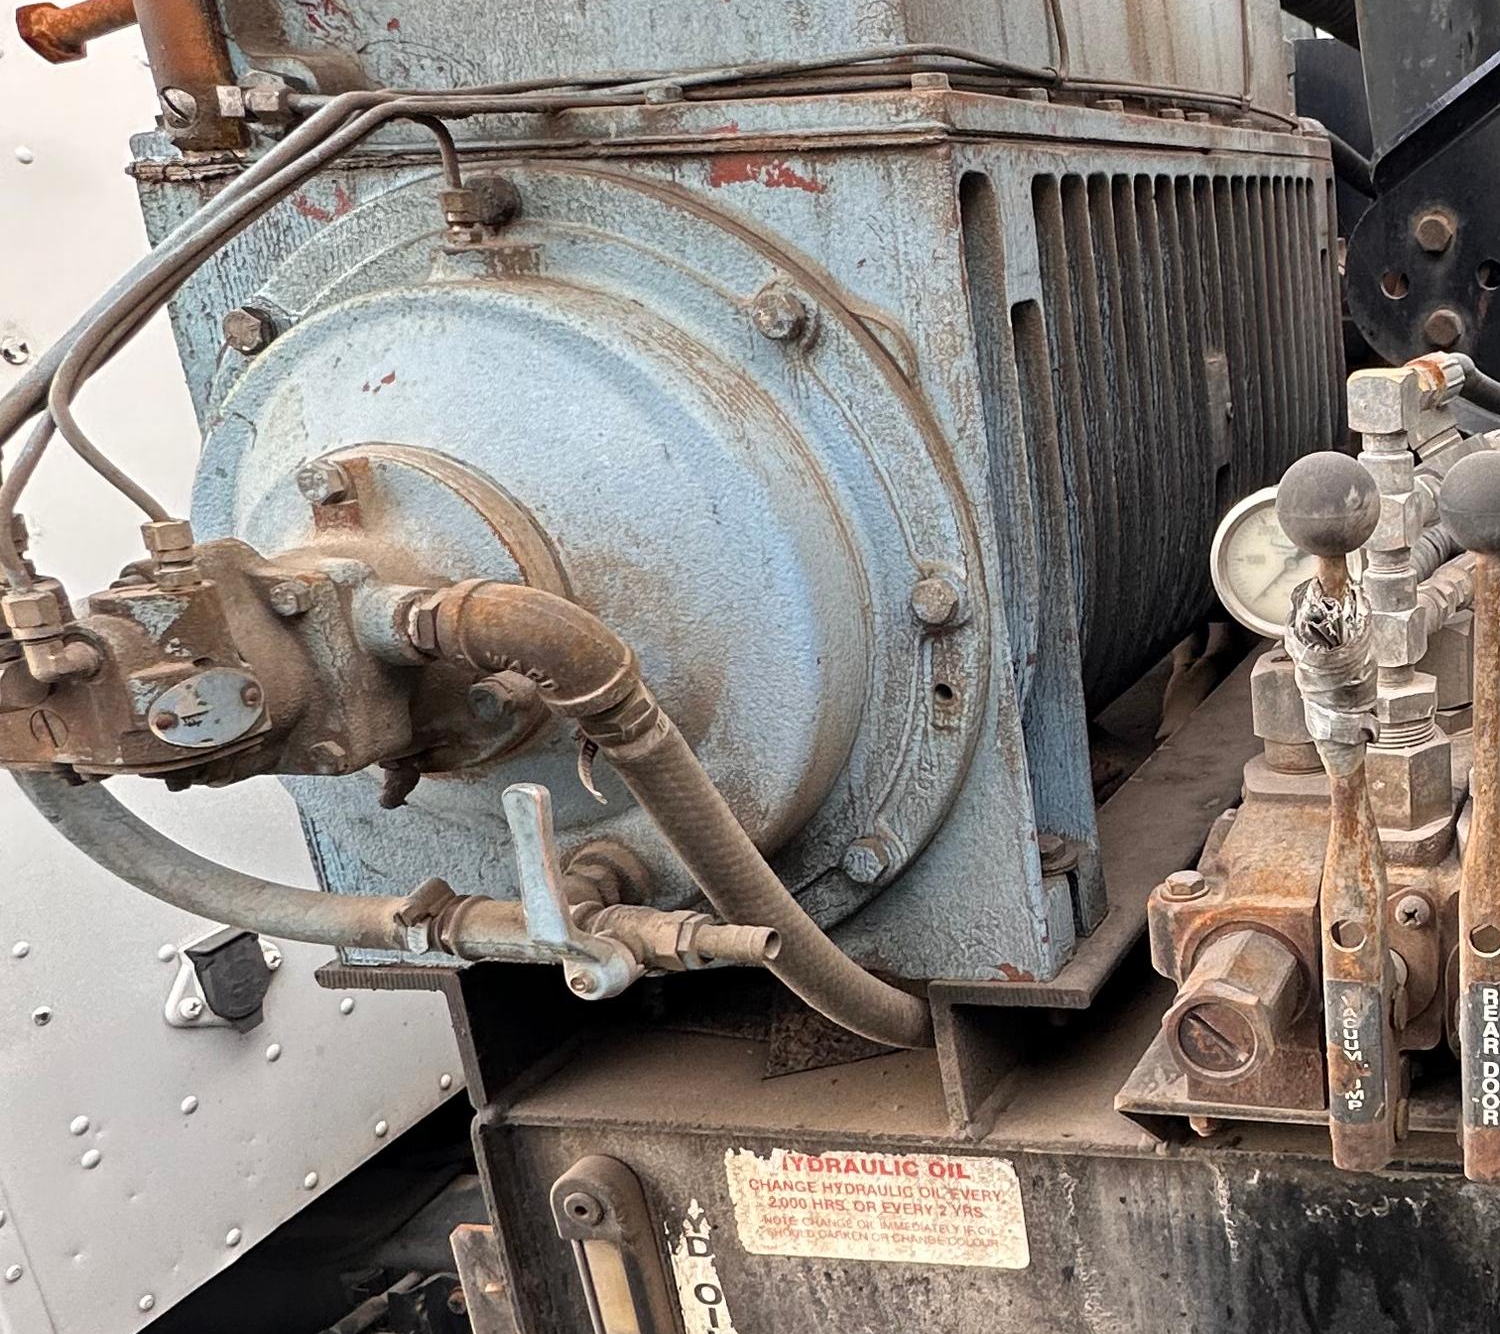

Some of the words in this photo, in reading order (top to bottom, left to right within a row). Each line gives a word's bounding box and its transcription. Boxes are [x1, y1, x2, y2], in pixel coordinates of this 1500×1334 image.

[1482, 988, 1499, 1055] REAR
[1481, 1062, 1499, 1126] DOOR
[928, 1161, 971, 1179] OIL
[749, 1178, 817, 1194] CHANGE
[822, 1181, 914, 1198] HYDRAULIC
[919, 1186, 946, 1200] OIL
[950, 1188, 1001, 1202] EVERY
[854, 1200, 876, 1213] OR
[882, 1202, 932, 1216] EVERY
[939, 1204, 947, 1217] 2
[802, 1217, 852, 1228] CHANGE
[881, 1220, 960, 1235] IMMEDIATELY
